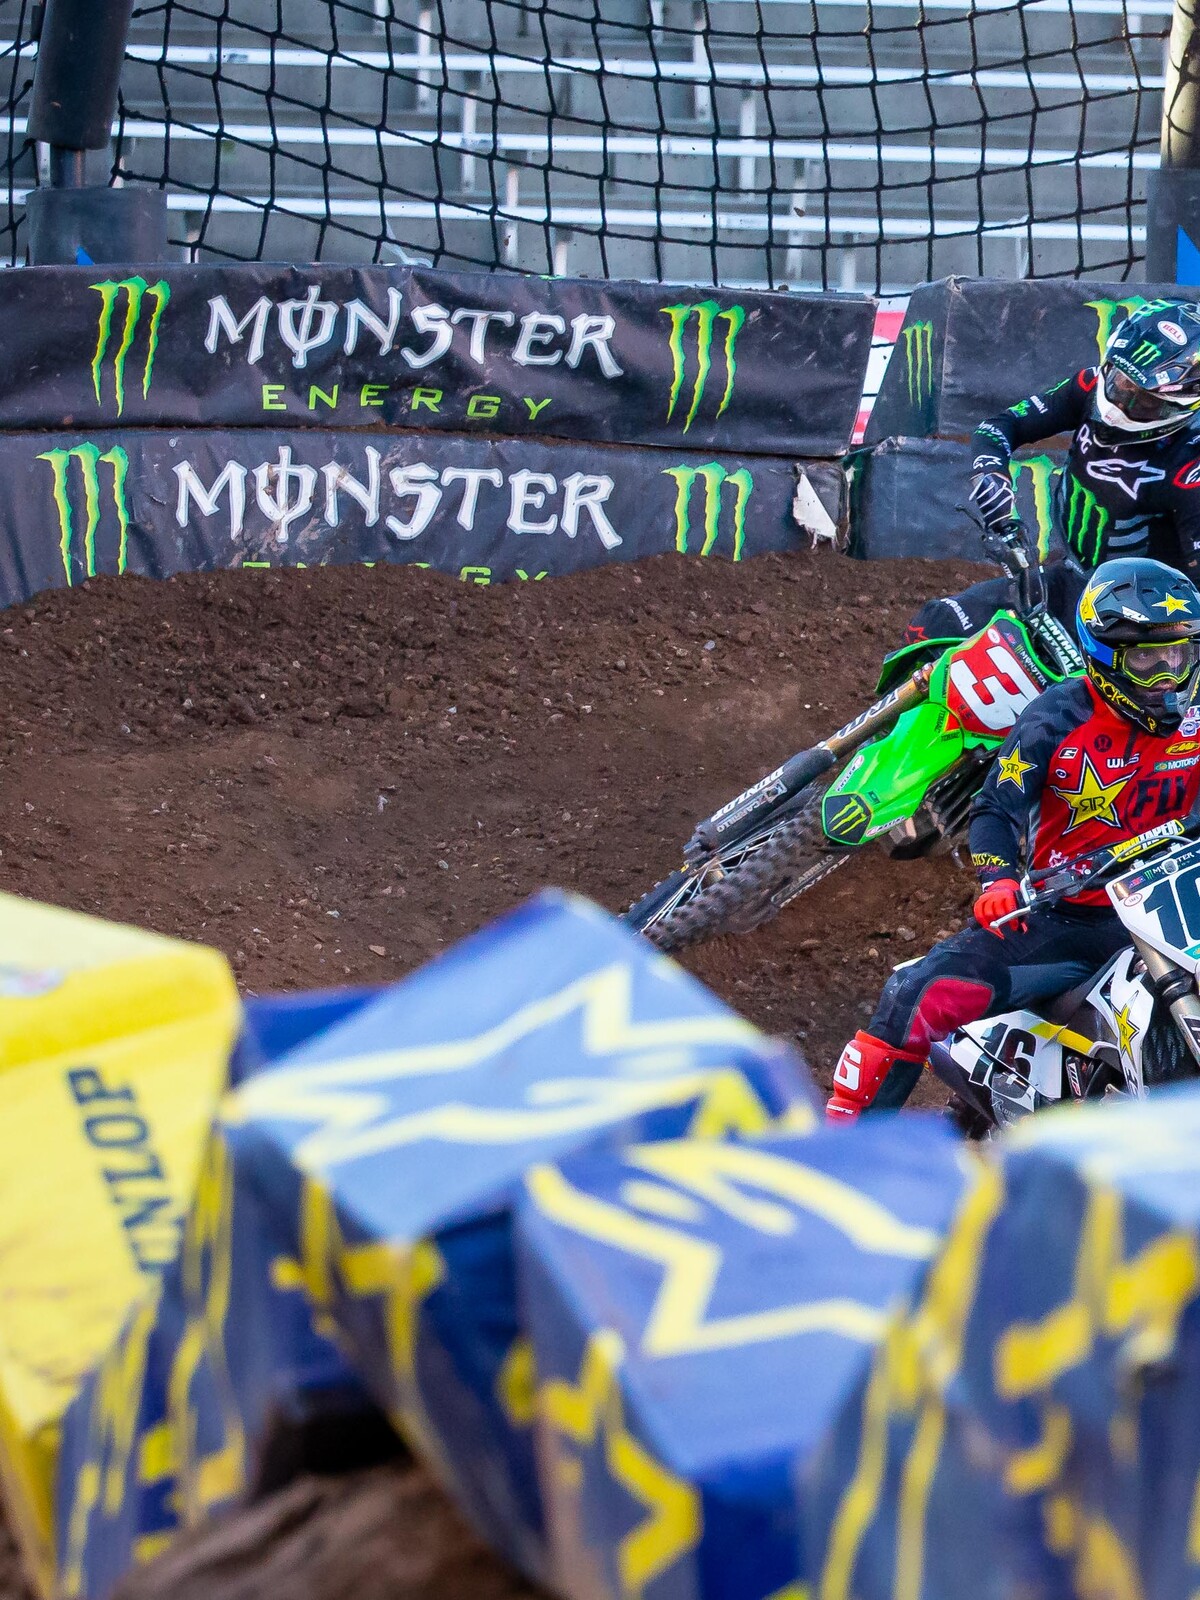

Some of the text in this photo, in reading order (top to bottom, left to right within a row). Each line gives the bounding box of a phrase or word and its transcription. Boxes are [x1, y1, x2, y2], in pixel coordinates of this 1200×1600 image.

[205, 285, 624, 377] MONSTER
[1163, 324, 1182, 340] BELL
[262, 383, 552, 422] ENERGY
[173, 445, 624, 549] MONSTER
[950, 645, 1040, 731] 3
[711, 765, 785, 823] DUNLOP
[969, 1022, 1037, 1099] 16
